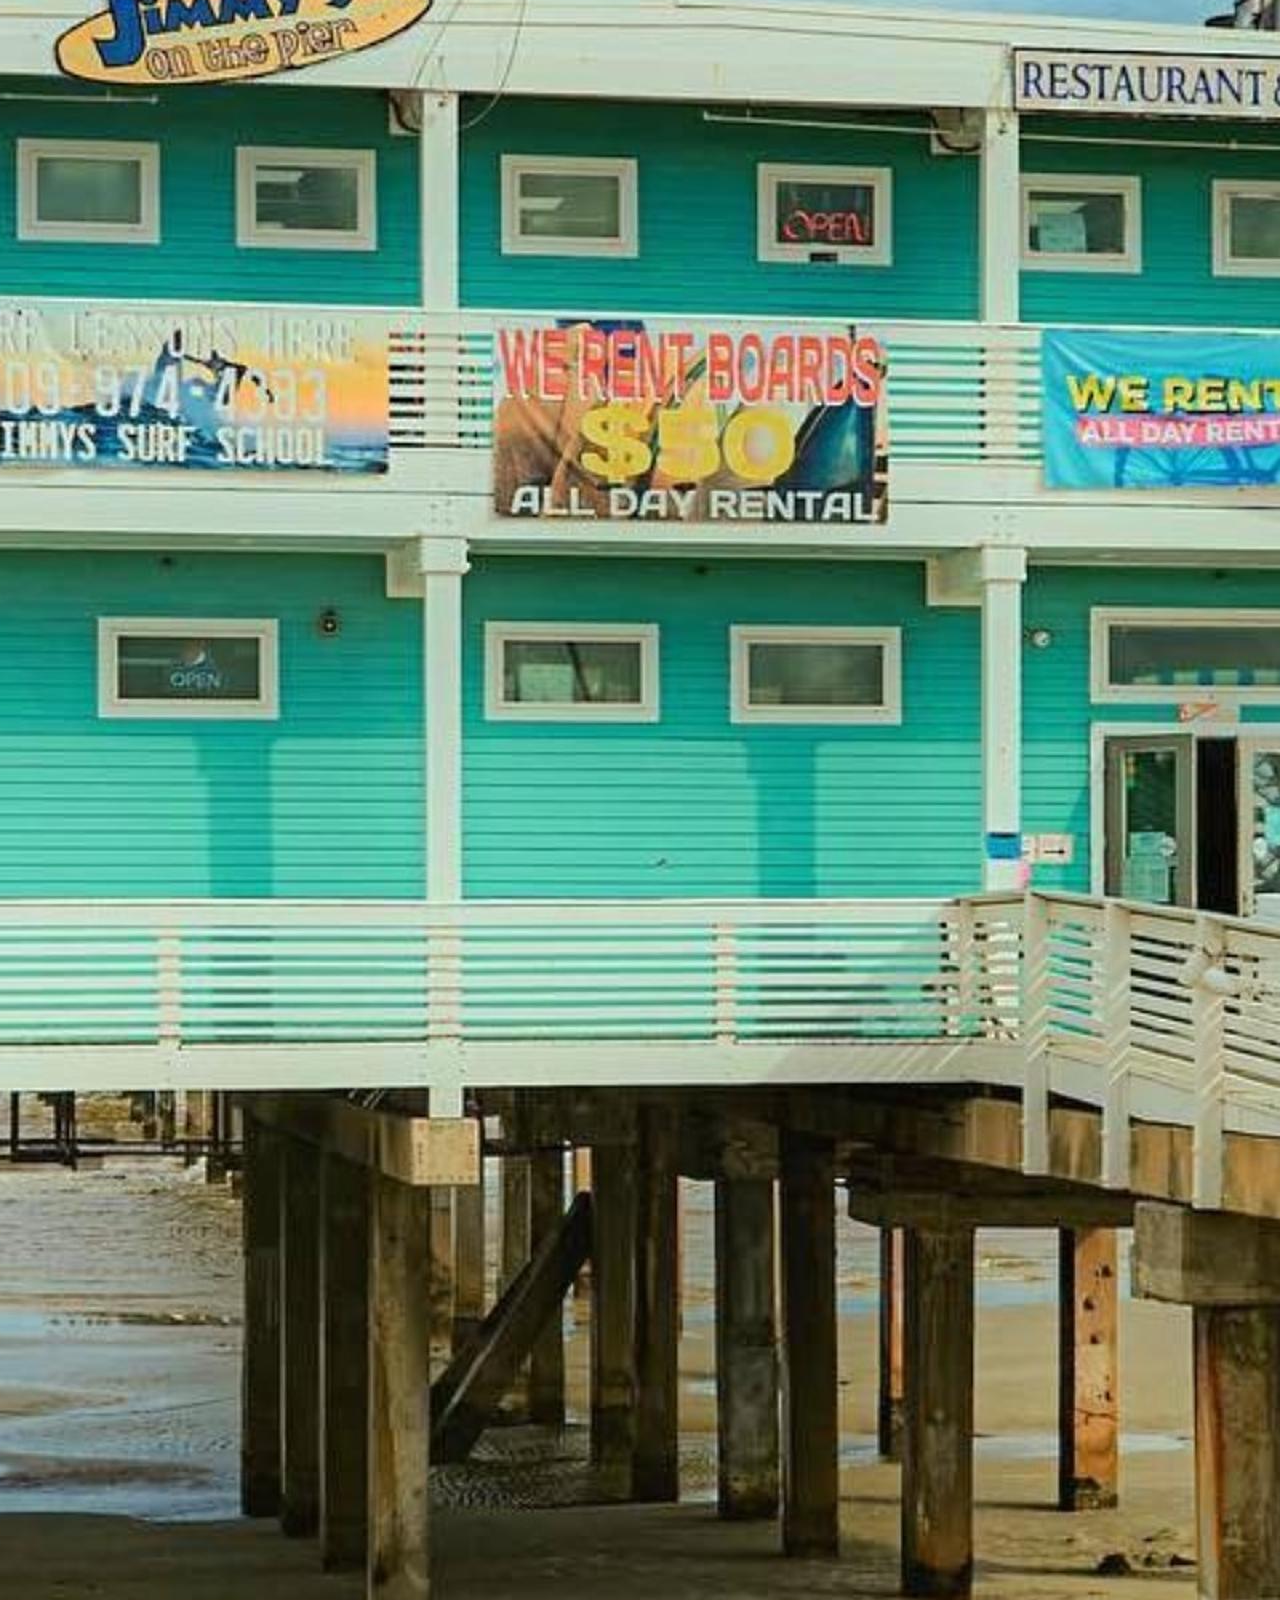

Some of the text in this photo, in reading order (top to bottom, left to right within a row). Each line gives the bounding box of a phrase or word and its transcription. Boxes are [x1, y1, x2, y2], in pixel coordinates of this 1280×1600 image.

[145, 18, 358, 79] on the pier
[1022, 61, 1267, 106] RESTAURANT
[782, 208, 869, 243] OPEN
[497, 327, 882, 406] WE RENT BOARDS
[1066, 374, 1149, 412] WE
[117, 423, 193, 462] SURF
[217, 425, 333, 466] SCHOOL
[579, 403, 797, 485] $50
[1080, 421, 1135, 445] ALL
[1141, 422, 1199, 444] DAY
[511, 485, 878, 522] ALL DAY RENTAL
[170, 670, 220, 689] OPEN
